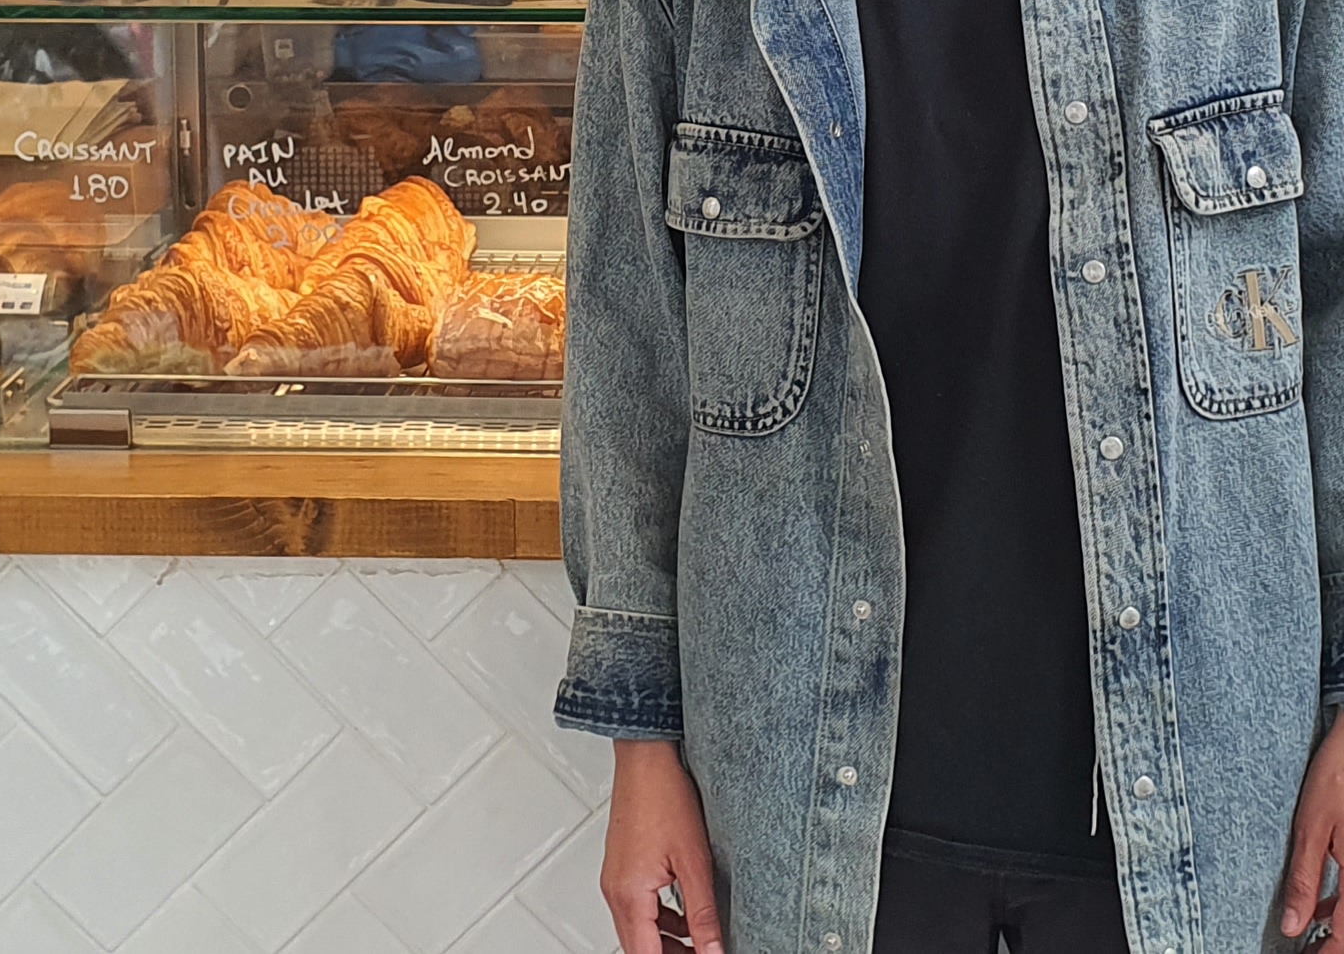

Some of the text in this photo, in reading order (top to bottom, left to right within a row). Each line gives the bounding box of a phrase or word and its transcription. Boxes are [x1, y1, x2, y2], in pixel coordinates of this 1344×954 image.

[13, 131, 158, 165] CROISSANT
[223, 136, 296, 168] PAIN
[422, 126, 536, 167] Almond
[248, 166, 288, 187] AU
[443, 162, 573, 188] CROISSAN
